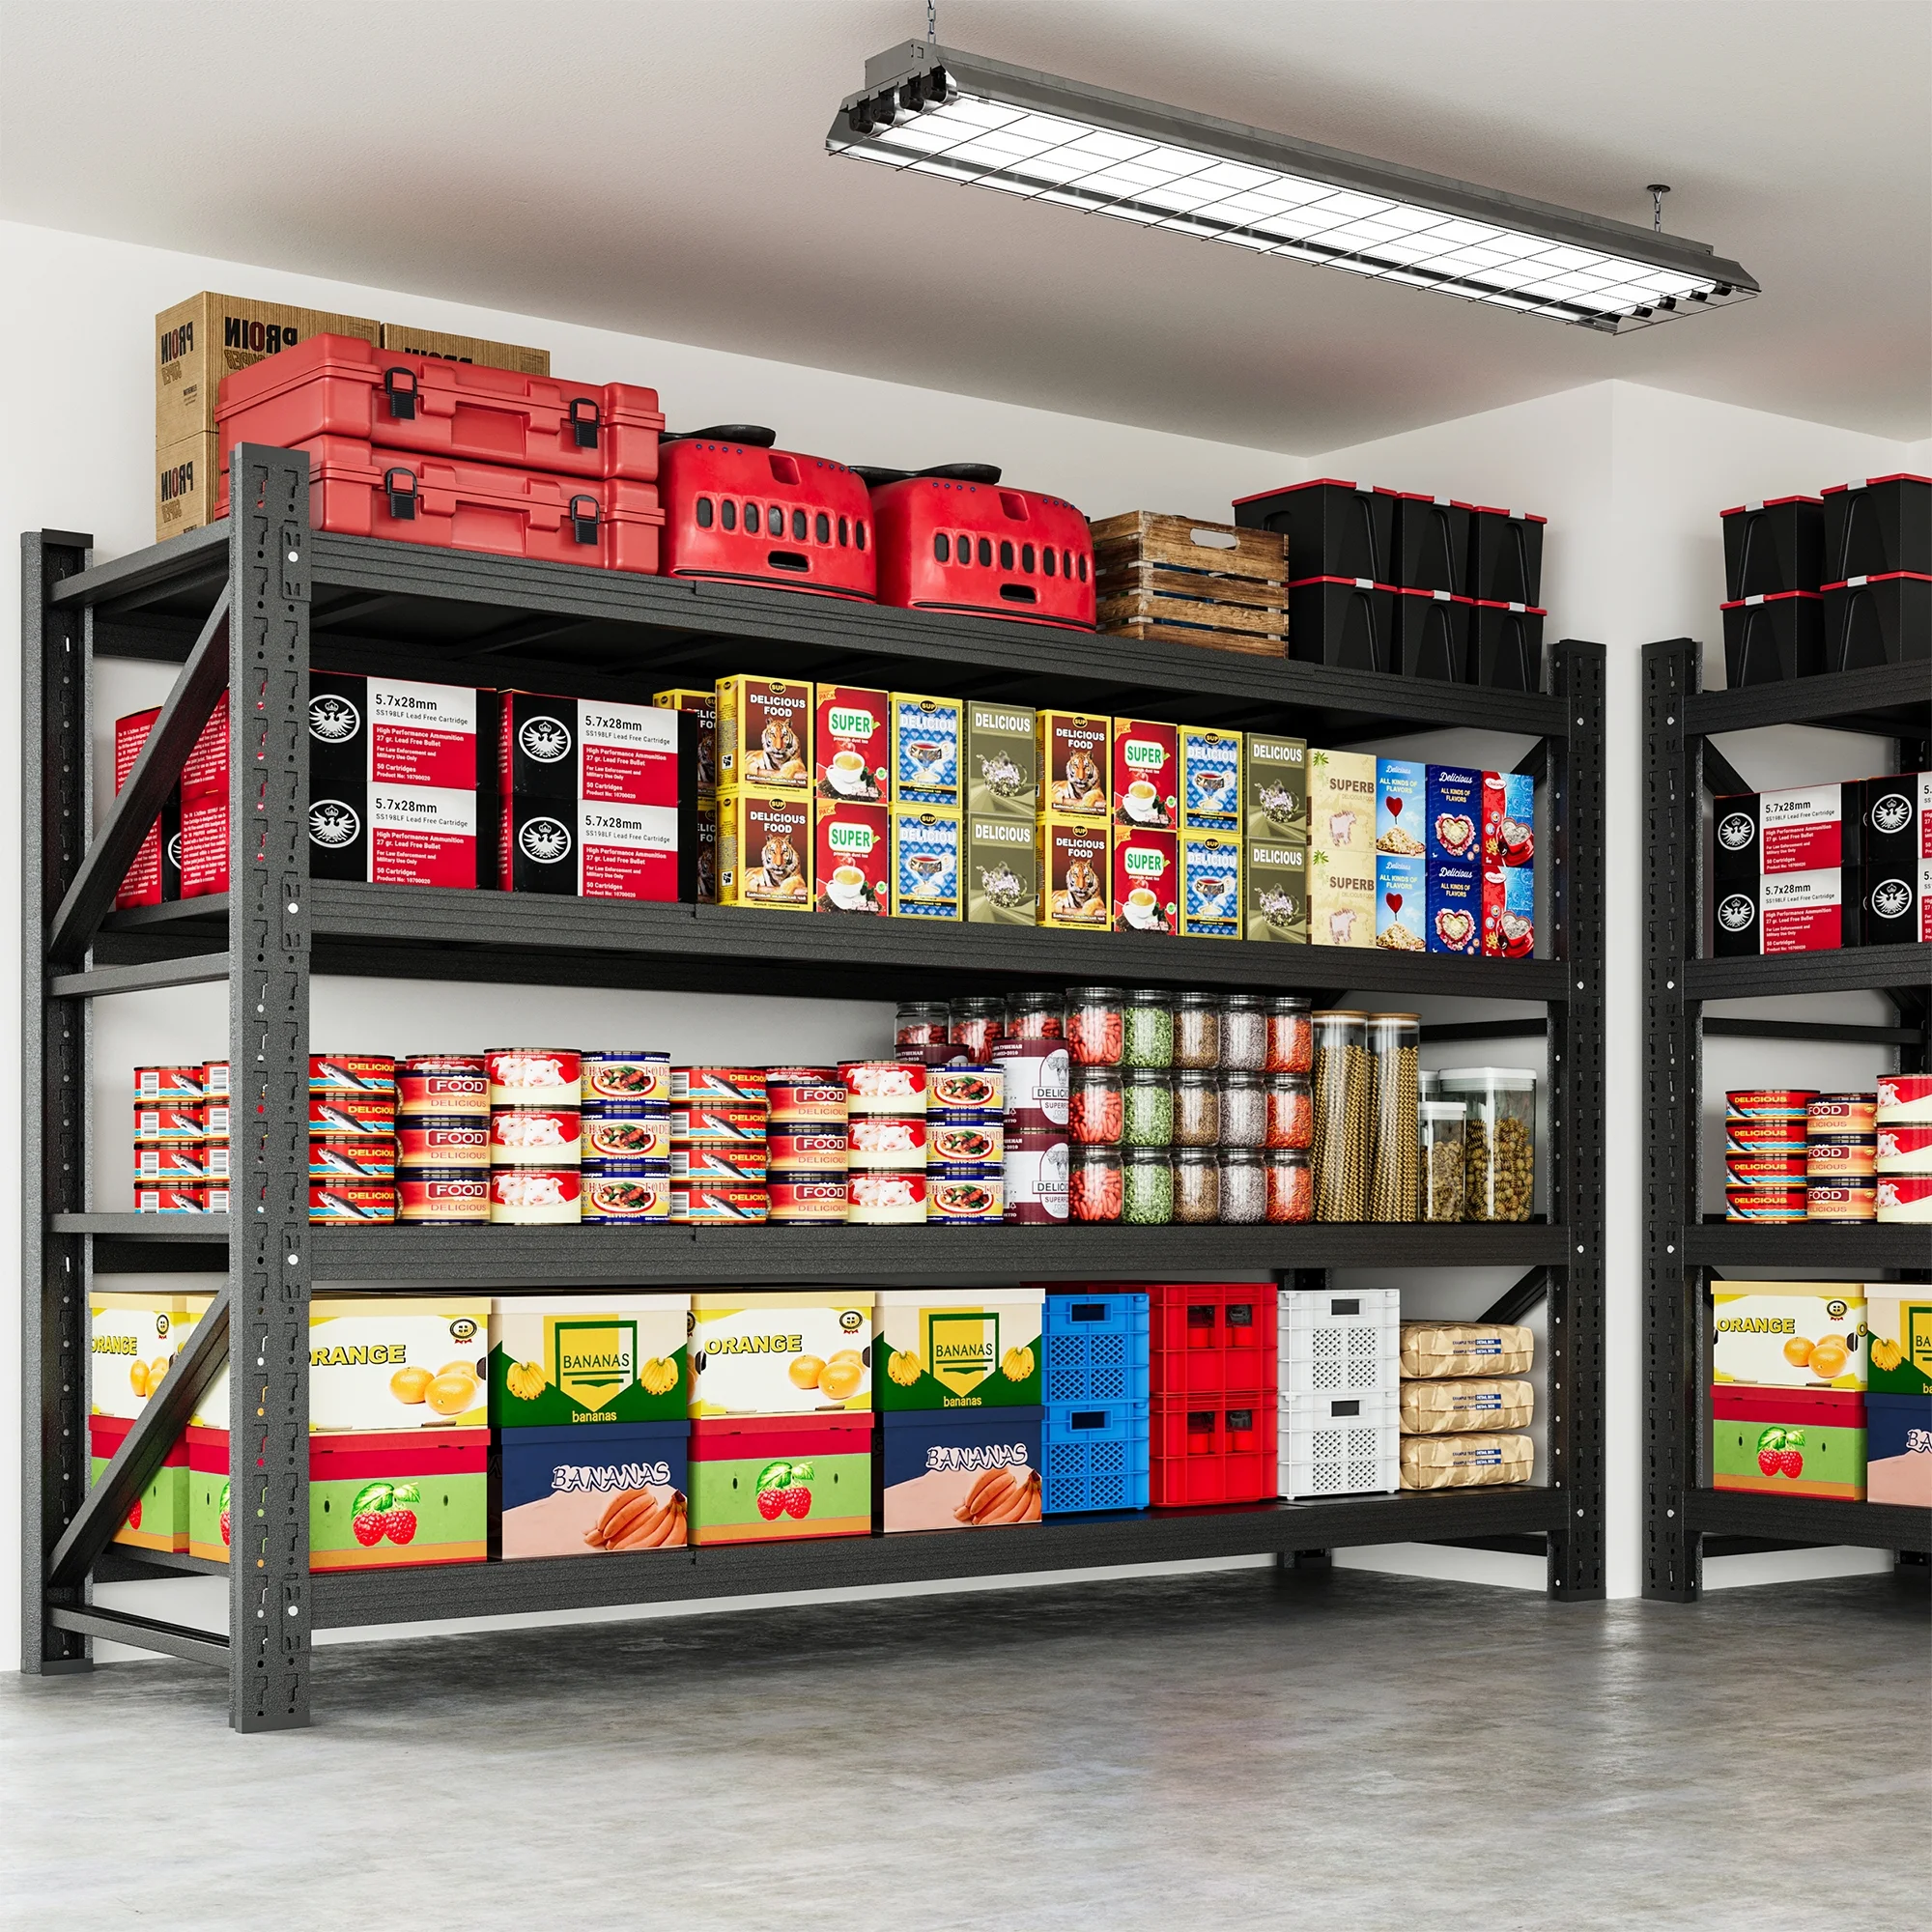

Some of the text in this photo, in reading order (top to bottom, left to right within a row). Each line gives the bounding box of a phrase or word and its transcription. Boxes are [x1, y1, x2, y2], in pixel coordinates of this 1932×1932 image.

[376, 694, 437, 710] 5.7x28mm
[751, 695, 806, 708] DELICIOUS
[376, 709, 404, 718] SS198LF
[439, 716, 468, 725] Cartridge
[764, 706, 792, 717] FOOD
[585, 716, 642, 731] 5.7x28mm
[832, 713, 870, 733] SUPER
[976, 713, 1031, 732] DELICIOUS
[643, 736, 670, 745] Cartridge
[1056, 728, 1105, 741] DELICIOUS
[1068, 740, 1094, 750] FOOD
[1127, 746, 1161, 763] SUPER
[1254, 744, 1302, 761] DELICIOUS
[385, 764, 416, 773] Cartridges
[1439, 772, 1472, 783] Delicious
[1330, 779, 1375, 793] SUPERB
[376, 797, 437, 814] 5.7x28mm
[1766, 802, 1811, 813] 5.7x28mm
[439, 818, 468, 828] Cartridge
[585, 815, 642, 830] 5.7x28mm
[751, 811, 806, 824] DELICIOUS
[764, 823, 792, 834] FOOD
[976, 824, 1031, 843] DELICIOUS
[832, 828, 870, 847] SUPER
[1056, 838, 1105, 849] DELICIOUS
[1068, 848, 1094, 858] FOOD
[1254, 848, 1302, 866] DELICIOUS
[1127, 854, 1161, 870] SUPER
[1439, 867, 1472, 878] Delicious
[1330, 876, 1375, 891] SUPERB
[1766, 885, 1811, 895] 5.7x28mm
[437, 1081, 483, 1092] FOOD
[804, 1091, 844, 1100] FOOD
[1808, 1106, 1841, 1115] FOOD
[437, 1133, 483, 1144] FOOD
[804, 1139, 844, 1149] FOOD
[1808, 1149, 1841, 1157] FOOD
[437, 1184, 483, 1196] FOOD
[804, 1187, 844, 1197] FOOD
[1808, 1191, 1841, 1200] FOOD
[1717, 1318, 1795, 1334] ORANGE
[705, 1334, 802, 1356] ORANGE
[935, 1342, 993, 1358] BANANAS
[309, 1345, 406, 1366] RANGE
[564, 1353, 630, 1369] BANANAS
[943, 1395, 982, 1406] bananas
[572, 1410, 617, 1422] bananas
[925, 1442, 1028, 1472] BANANAS
[552, 1462, 670, 1492] BANANAS
